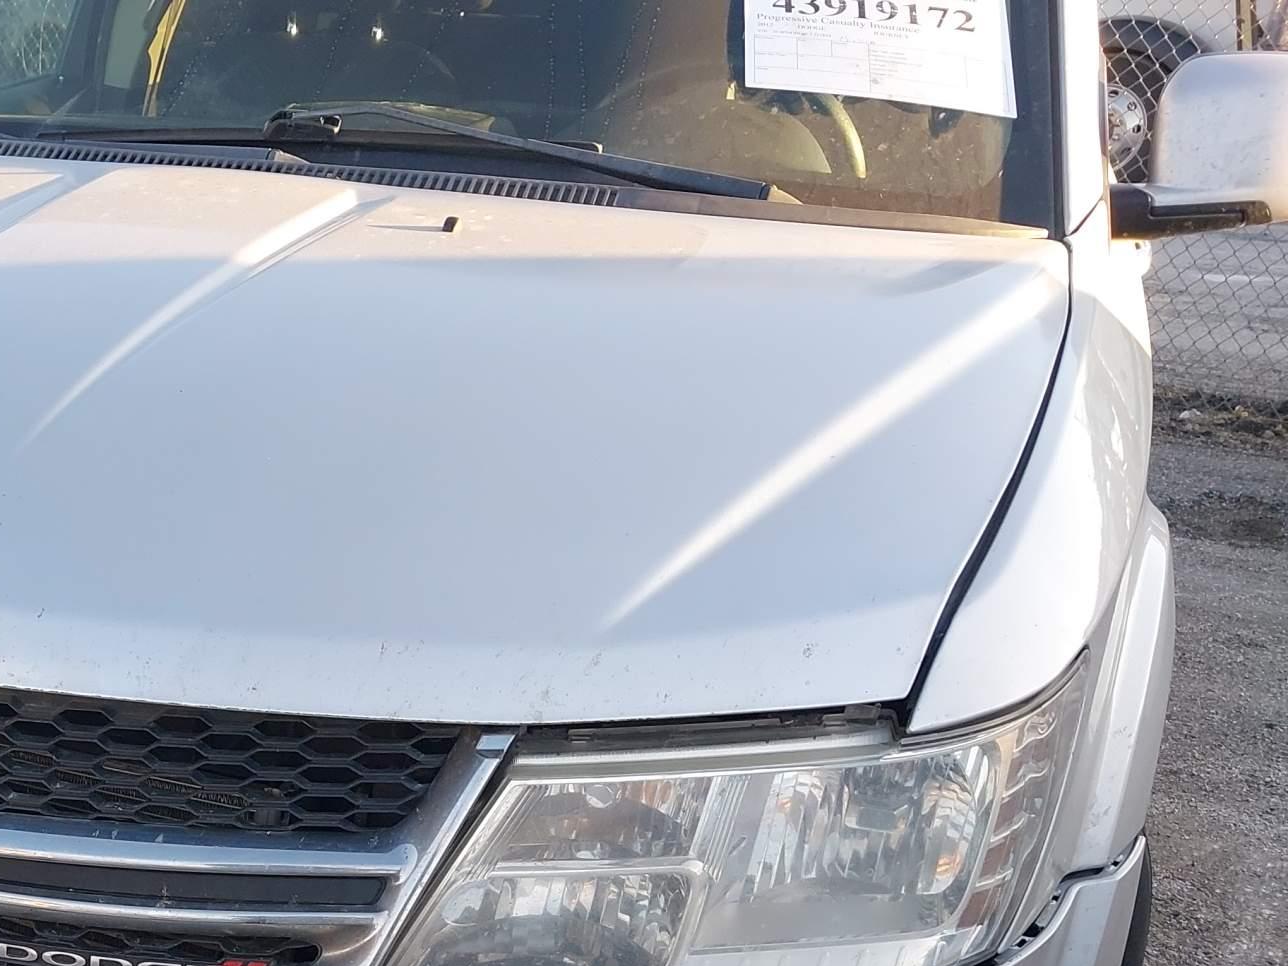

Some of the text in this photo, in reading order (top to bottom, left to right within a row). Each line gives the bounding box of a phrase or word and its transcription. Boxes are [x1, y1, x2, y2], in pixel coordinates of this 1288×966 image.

[757, 13, 920, 34] Progressive Casualty Insurance
[772, 0, 976, 32] 43919172
